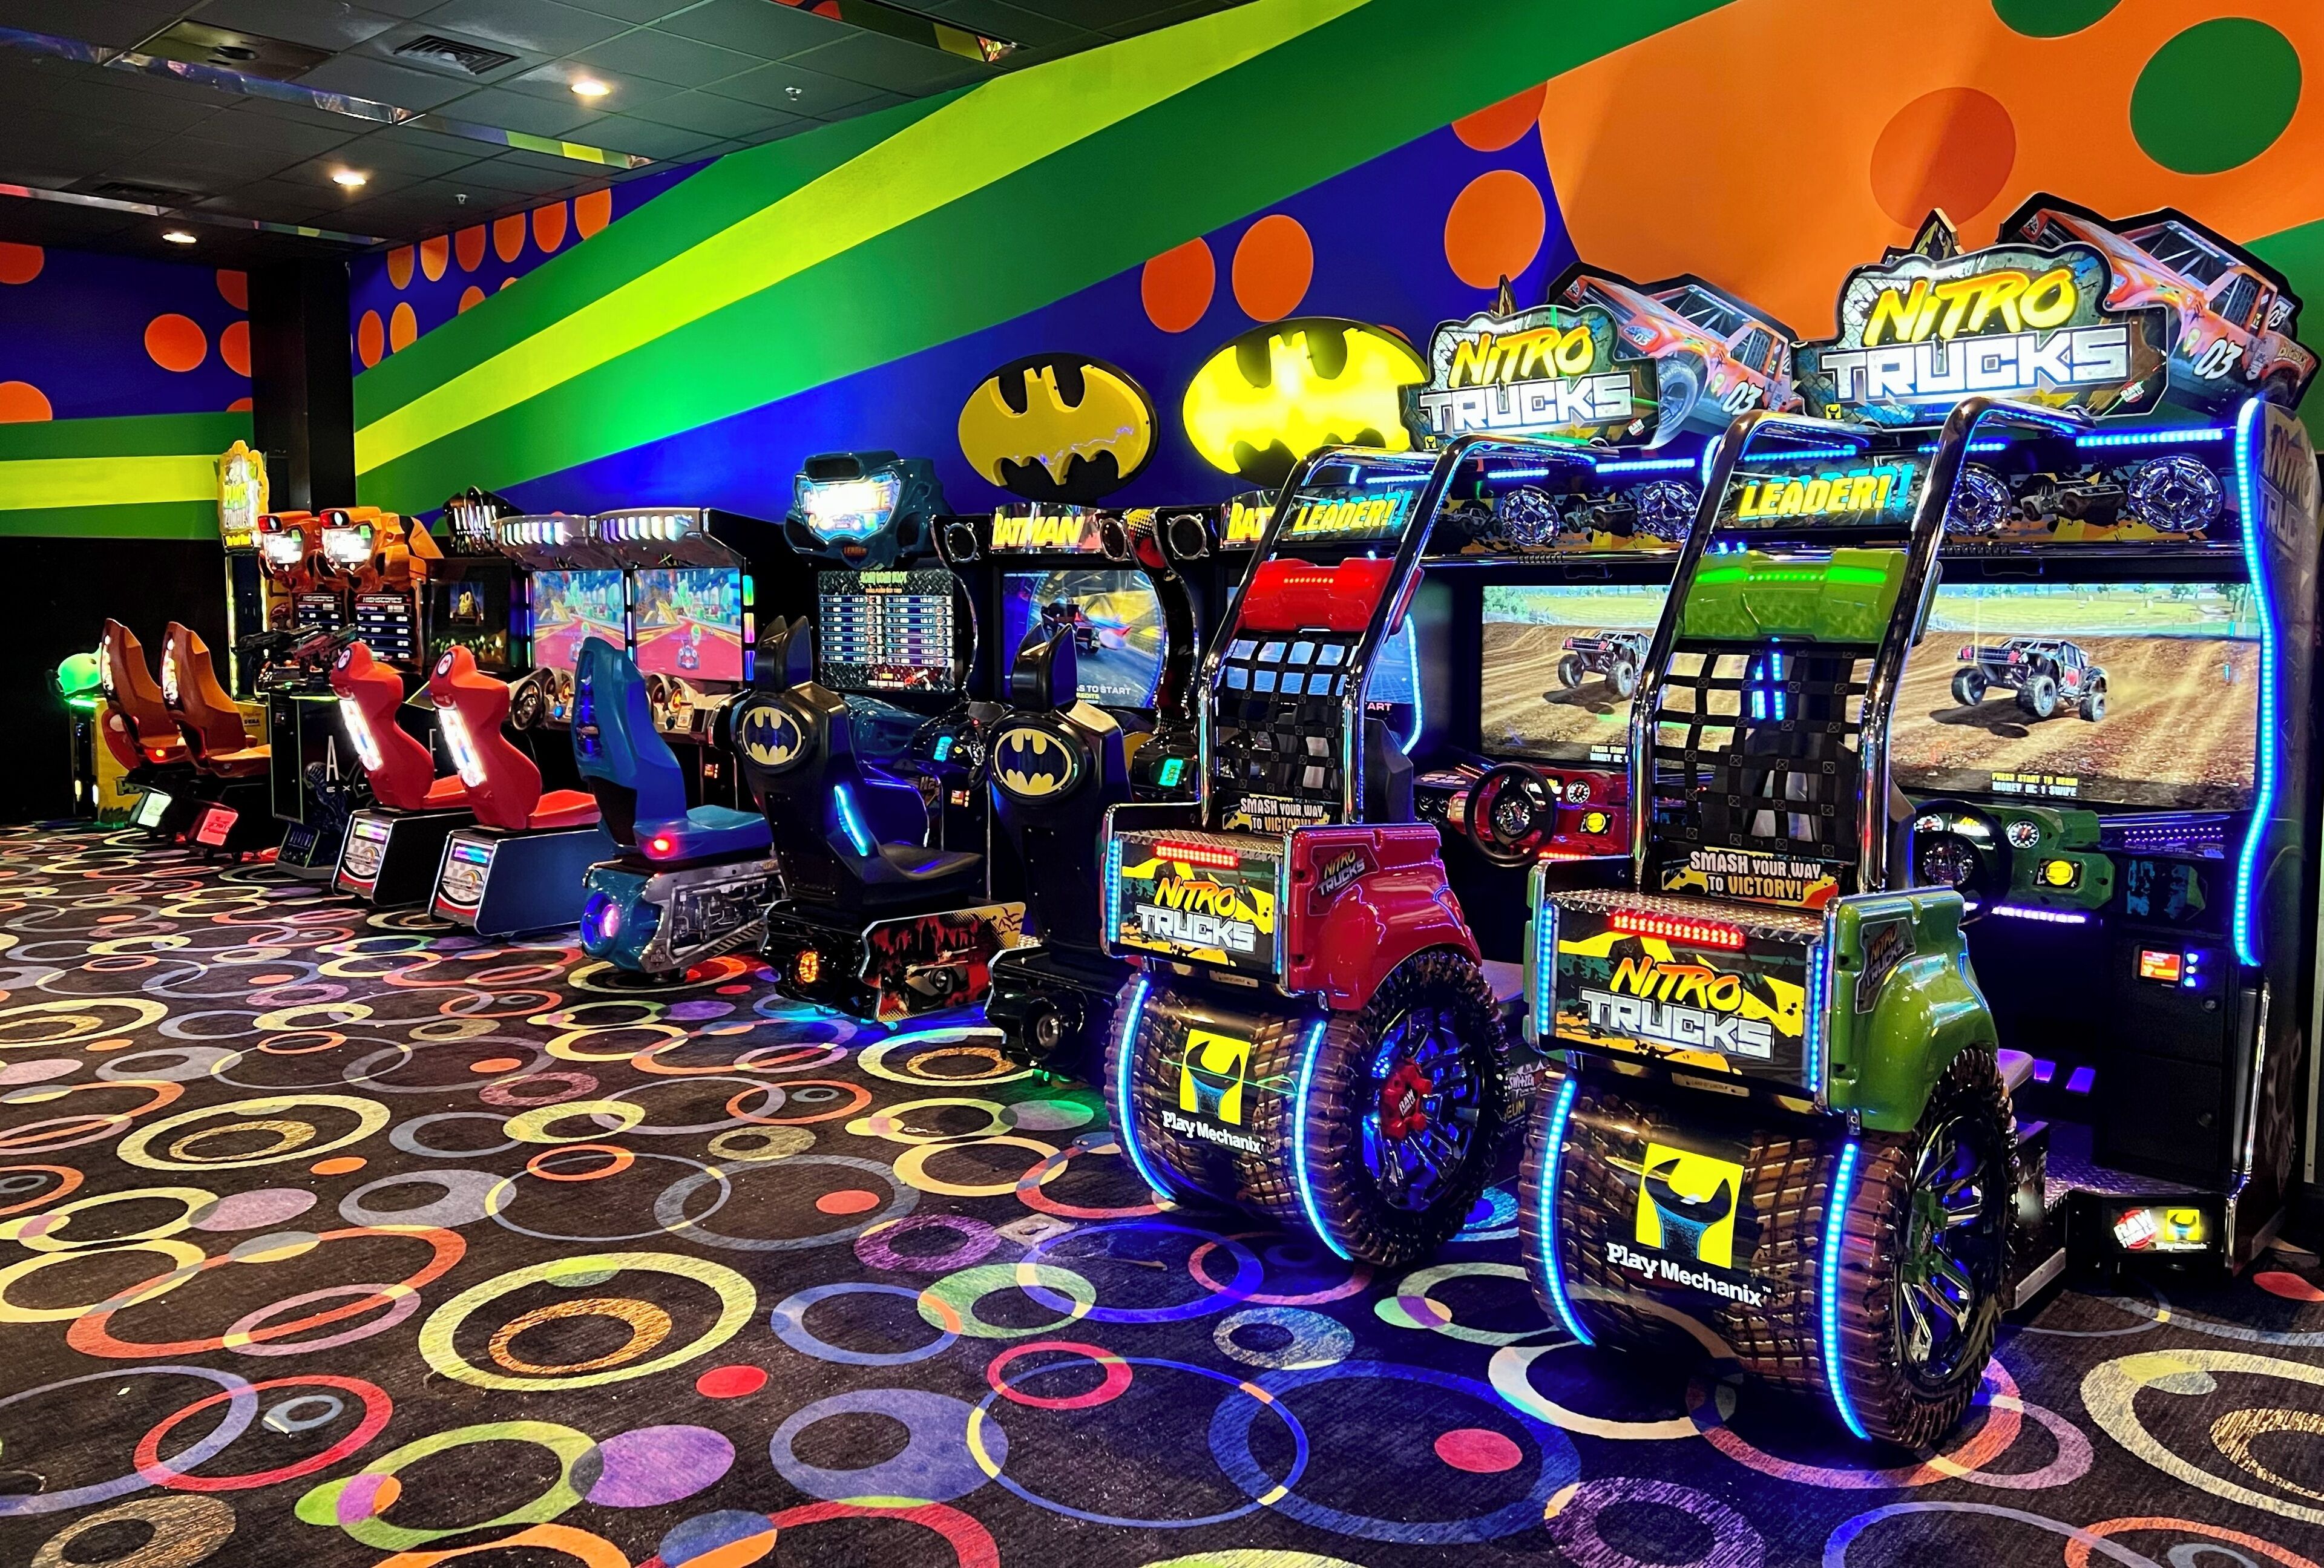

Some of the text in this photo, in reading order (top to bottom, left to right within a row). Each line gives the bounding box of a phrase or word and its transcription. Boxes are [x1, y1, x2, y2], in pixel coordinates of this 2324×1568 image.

[1820, 330, 2129, 401] TRUCKS
[2194, 339, 2243, 379] 03
[1419, 373, 1633, 434] TRUCKS
[1722, 381, 1764, 416] 03
[1738, 474, 1893, 518] LEADER!
[2258, 474, 2302, 552] TRUC
[992, 513, 1086, 547] BATMAN
[1227, 502, 1276, 540] BAT
[1292, 499, 1397, 534] LEADER!
[1086, 684, 1099, 693] TO
[1100, 686, 1131, 695] START
[1365, 702, 1392, 711] ART
[1241, 798, 1324, 817] SMASH YOUR WAY
[2049, 785, 2077, 797] SWIPE
[1252, 818, 1262, 830] TO
[1318, 858, 1365, 896] TRUCKS
[1690, 851, 1821, 879] SMASH YOUR WAY
[1708, 875, 1802, 899] TO VICTORY!
[1136, 904, 1255, 953] TRUCKS
[1581, 989, 1772, 1059] TRUCKS
[1161, 1110, 1262, 1155] Play Mechanix
[1606, 1242, 1659, 1279] Play
[1660, 1259, 1762, 1307] Mechanix
